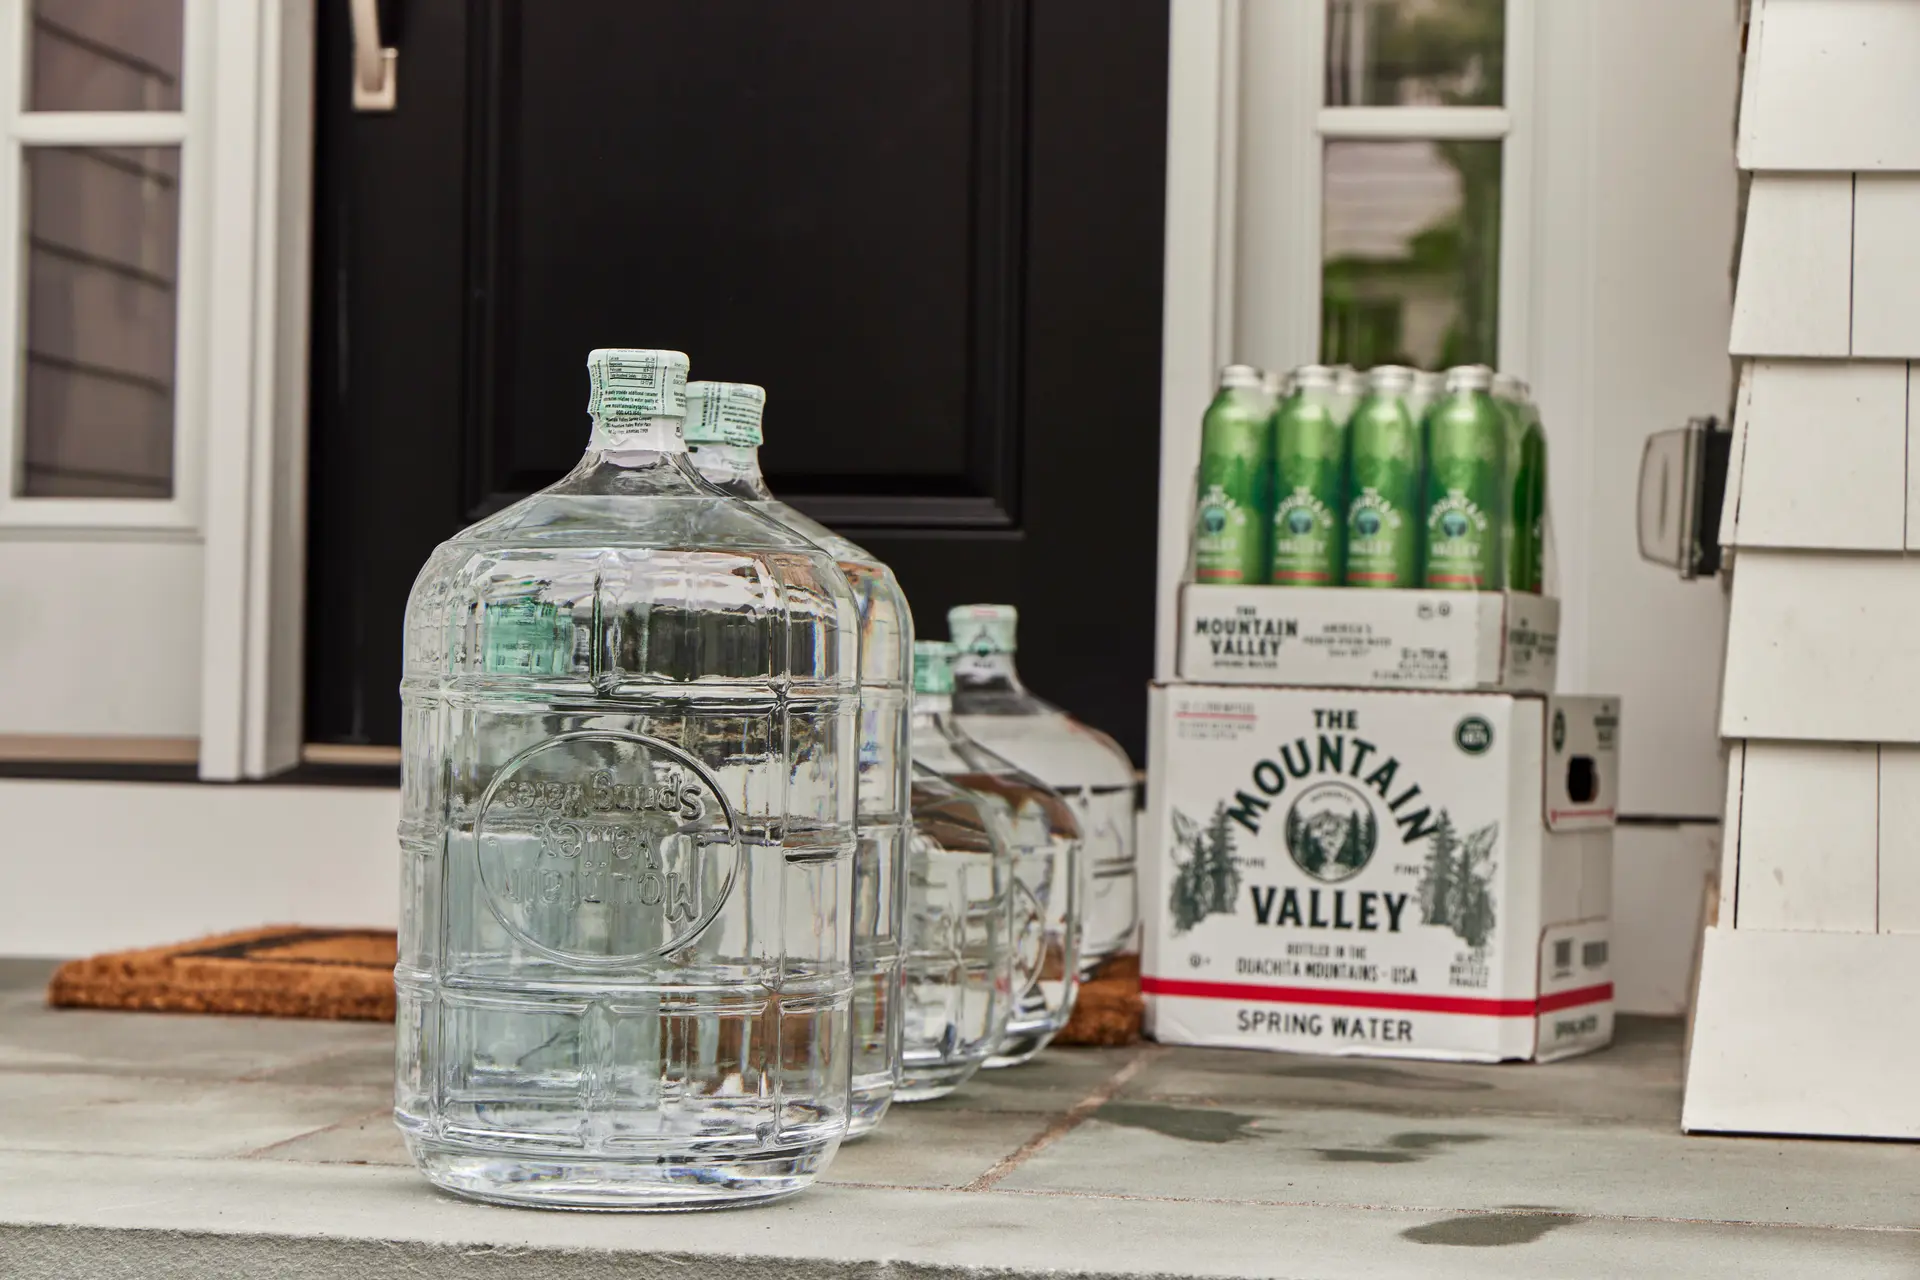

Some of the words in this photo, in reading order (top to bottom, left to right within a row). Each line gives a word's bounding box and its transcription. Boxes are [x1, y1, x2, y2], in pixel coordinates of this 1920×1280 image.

[1195, 616, 1298, 637] MOUNTAIN
[1210, 637, 1281, 657] VALLEY
[1313, 709, 1359, 731] THE
[1226, 735, 1440, 844] MOUNTAIN
[1250, 885, 1408, 933] VALLEY
[1236, 957, 1301, 977] OUACHITA
[1305, 960, 1379, 983] MOUNTAINS
[1391, 966, 1418, 984] USA
[1237, 1009, 1323, 1037] SPRING
[1331, 1016, 1413, 1043] WATER
